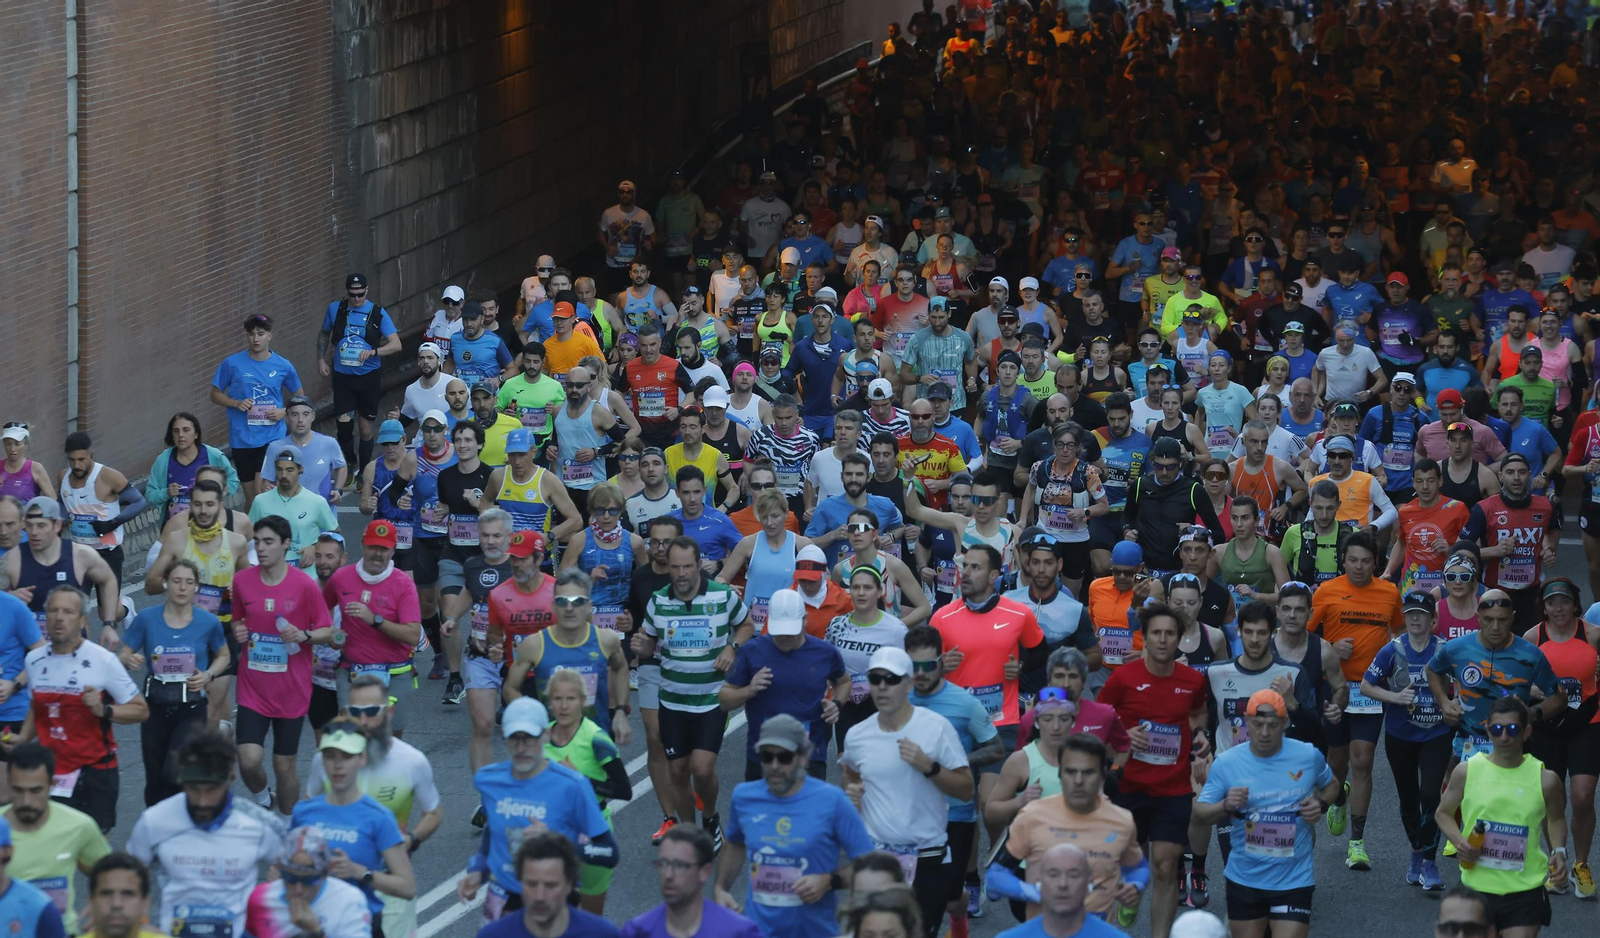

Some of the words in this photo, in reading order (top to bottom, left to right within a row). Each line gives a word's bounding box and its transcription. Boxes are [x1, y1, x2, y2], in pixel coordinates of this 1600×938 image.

[922, 461, 946, 472] VIVA!
[454, 530, 471, 538] SANTI
[482, 573, 497, 582] 88
[1505, 574, 1530, 582] XAVIER
[509, 612, 553, 622] ULTRA
[1102, 647, 1127, 656] ORENZ
[252, 655, 282, 664] DUARTE
[1154, 726, 1178, 734] ZURICH
[1147, 745, 1178, 756] UBRIER
[1262, 814, 1291, 822] ZURICH
[1493, 824, 1524, 836] ZURICH
[1246, 834, 1266, 845] JAVI
[1274, 836, 1294, 847] SILO
[1492, 838, 1508, 846] 9293
[764, 855, 796, 865] ZURICH
[1502, 850, 1524, 861] ROSA
